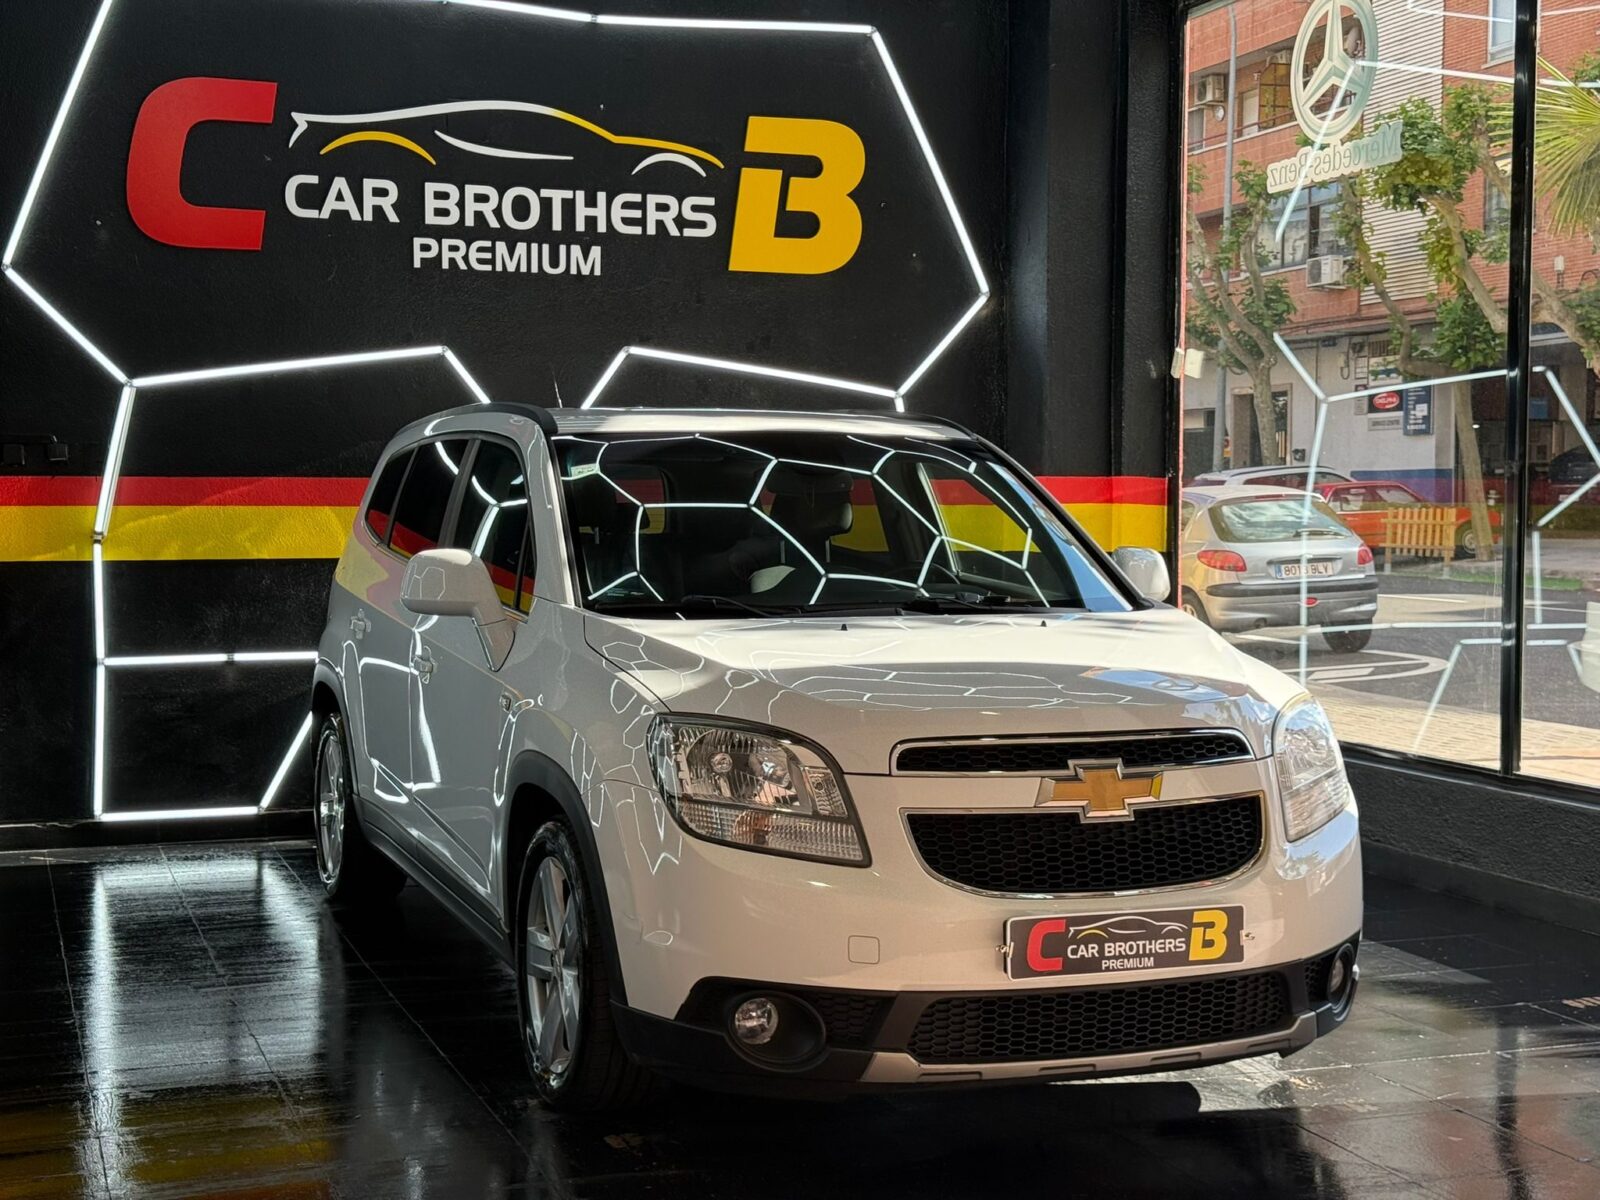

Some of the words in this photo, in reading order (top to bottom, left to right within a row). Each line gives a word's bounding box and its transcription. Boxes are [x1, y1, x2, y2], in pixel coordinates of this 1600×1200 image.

[127, 77, 278, 251] C
[284, 174, 400, 223] CAR
[423, 181, 718, 238] BROTHERS
[728, 115, 866, 275] B
[412, 237, 603, 277] PREMIUM
[1026, 919, 1067, 972] C
[1067, 944, 1099, 959] CAR
[1104, 937, 1186, 957] BROTHERS
[1188, 909, 1229, 962] B
[1101, 956, 1155, 971] PREMIUM
